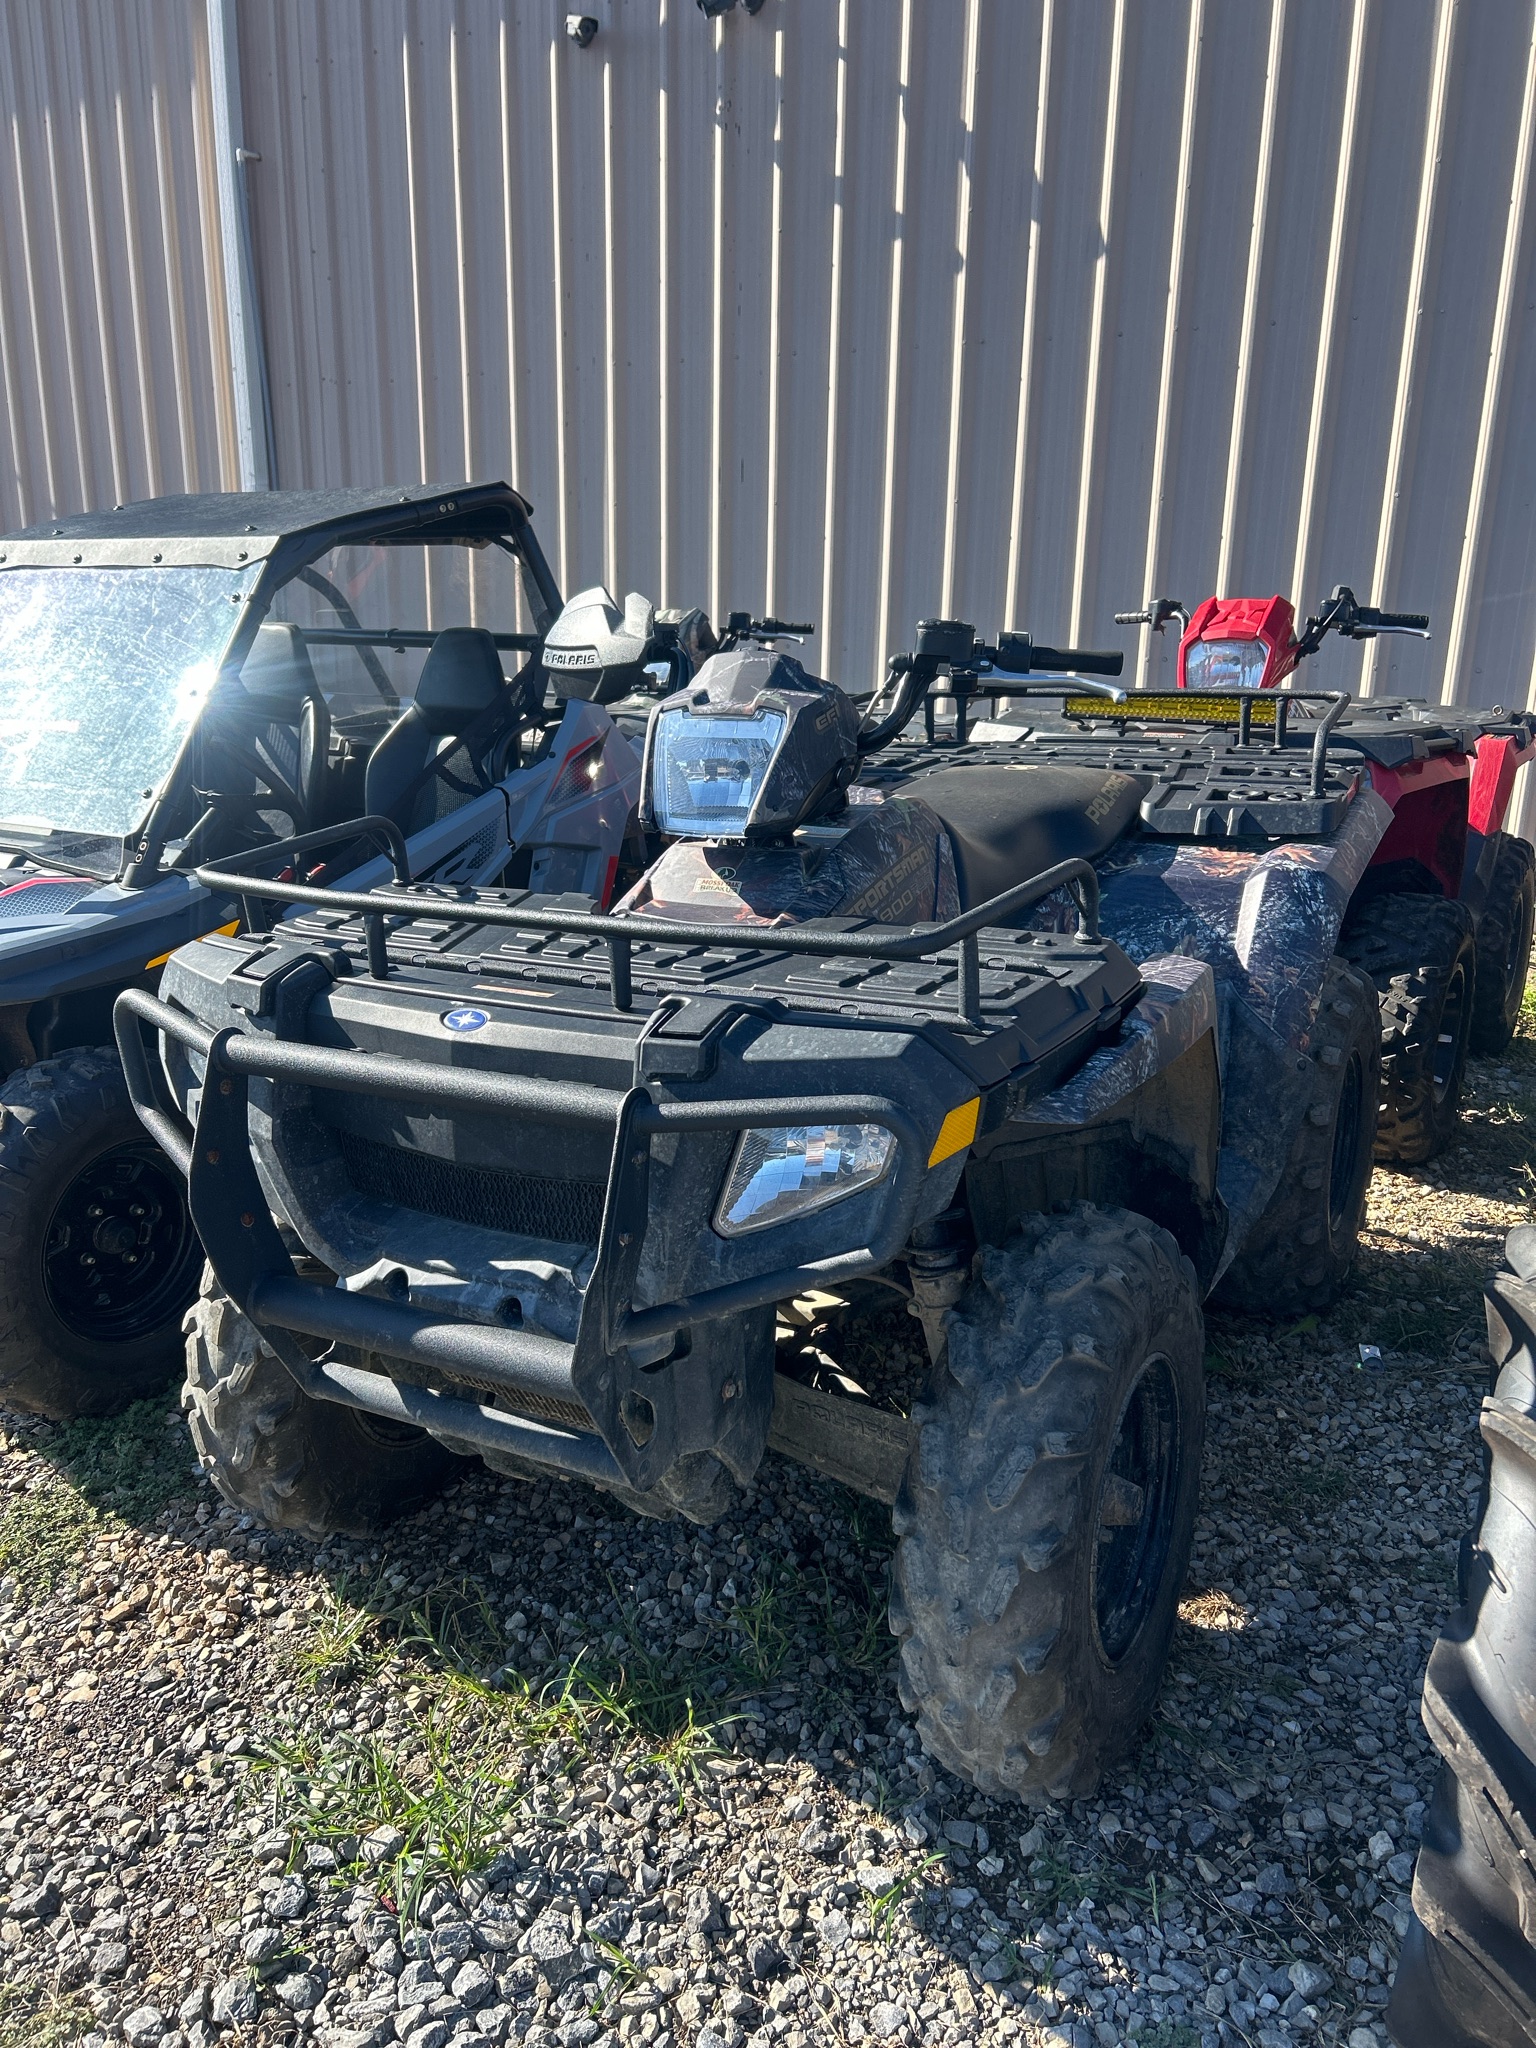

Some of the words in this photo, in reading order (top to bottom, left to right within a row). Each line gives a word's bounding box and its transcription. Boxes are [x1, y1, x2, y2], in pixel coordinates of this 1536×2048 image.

[551, 654, 596, 665] POLARIS
[815, 704, 840, 731] EFI
[1084, 774, 1129, 826] POLARIS
[880, 888, 914, 922] 800
[791, 1397, 910, 1450] POLARIS
